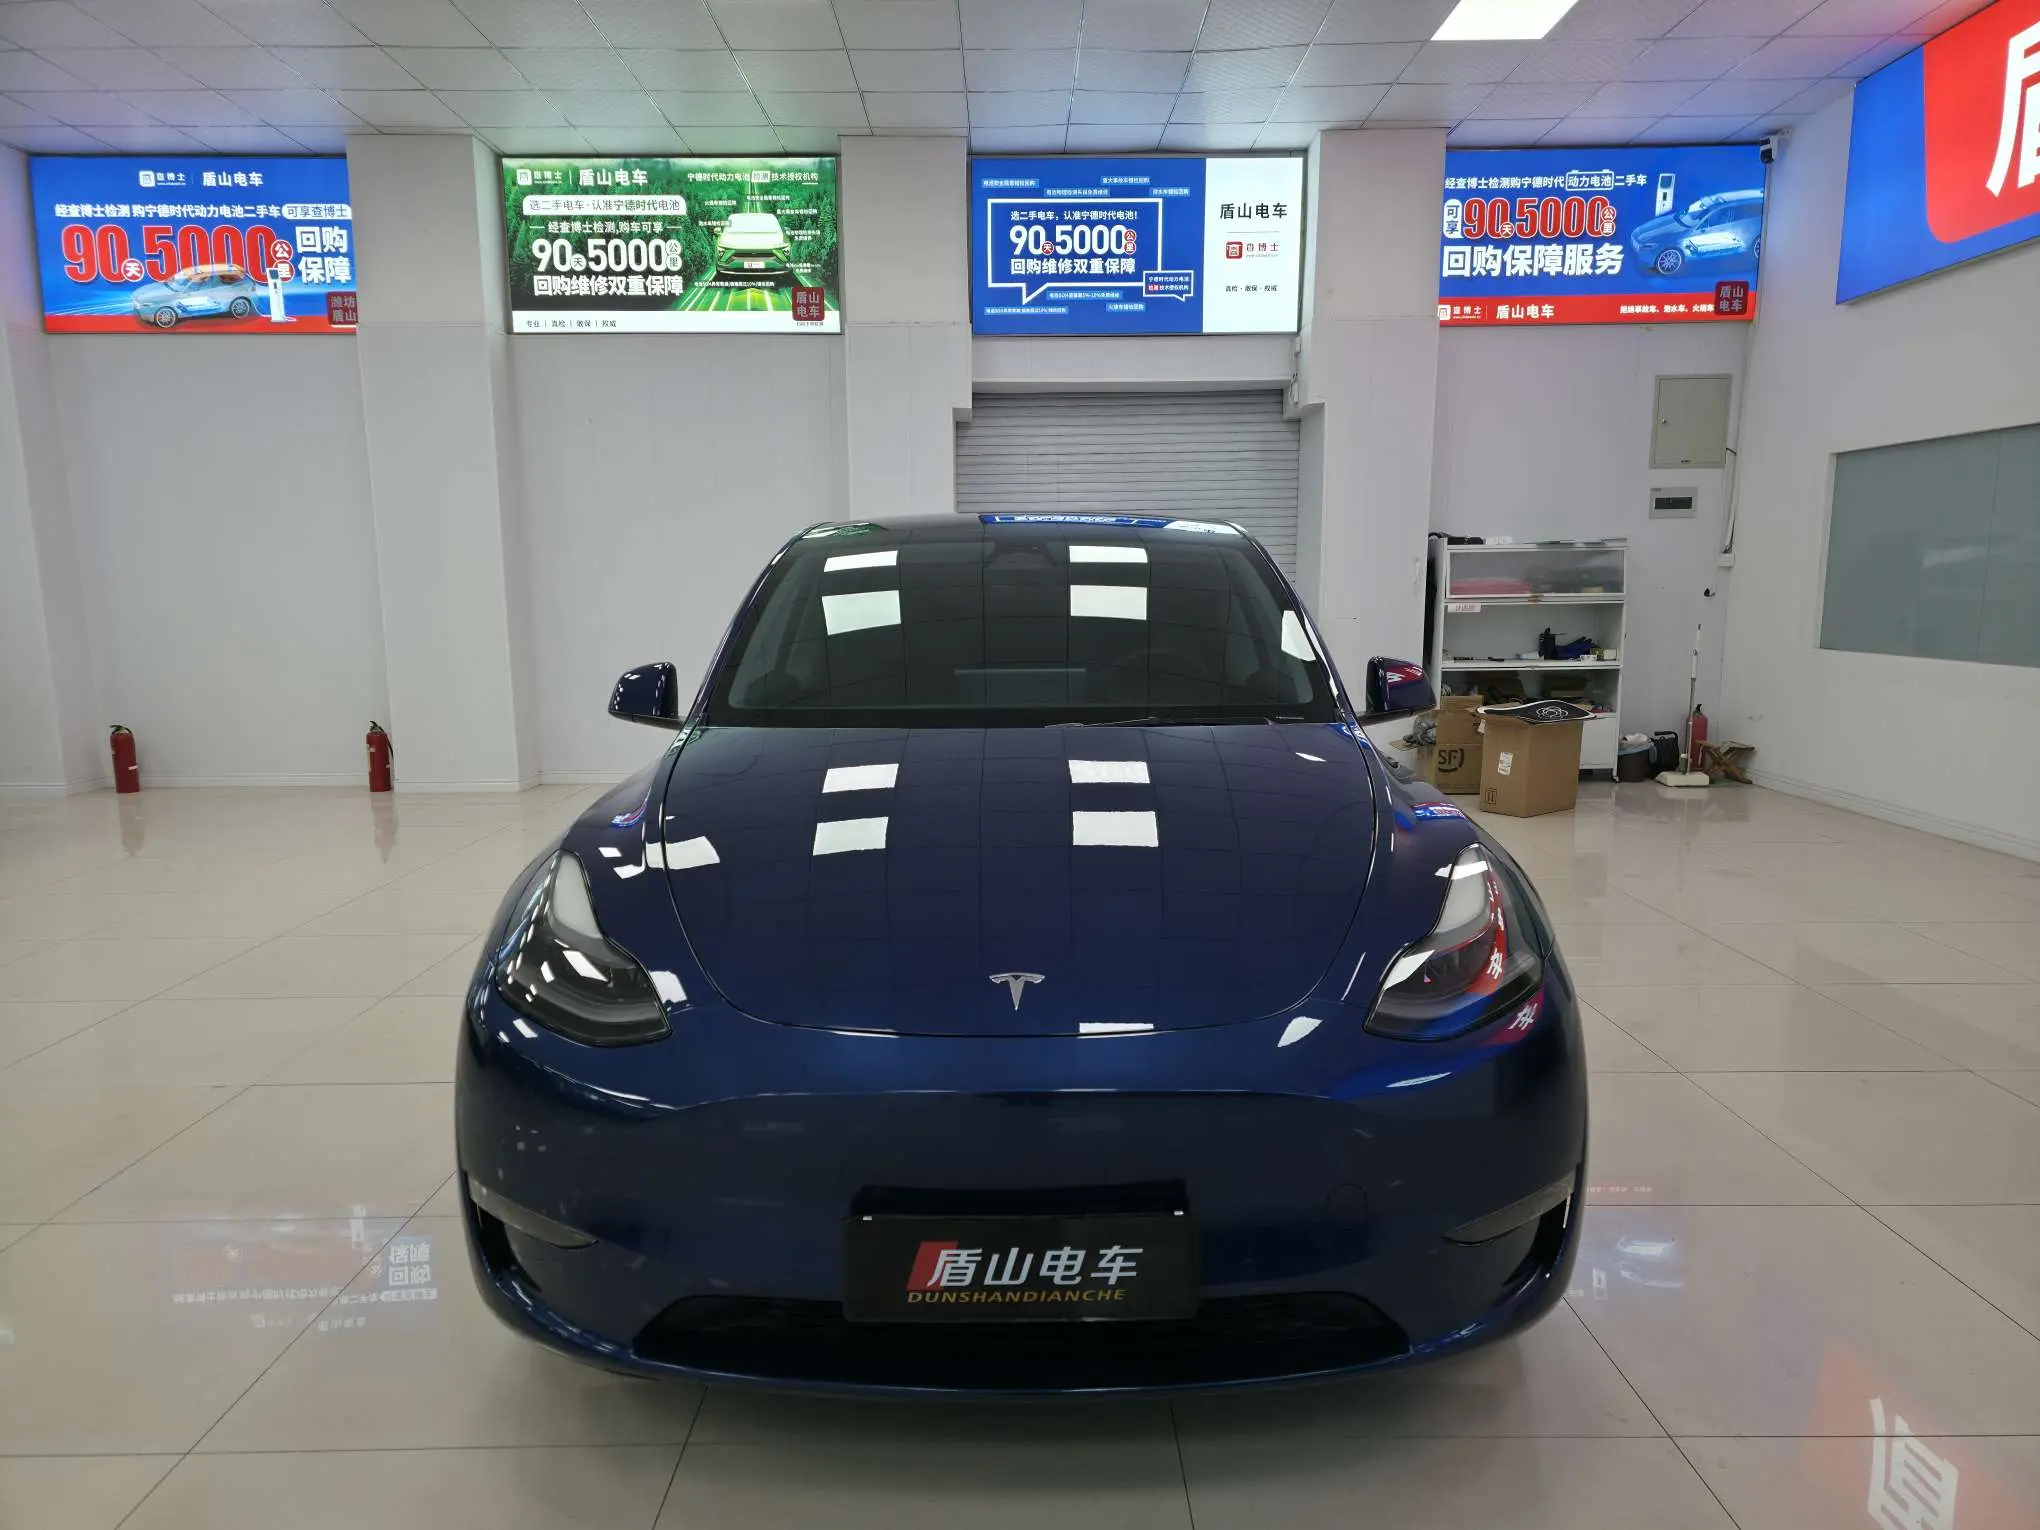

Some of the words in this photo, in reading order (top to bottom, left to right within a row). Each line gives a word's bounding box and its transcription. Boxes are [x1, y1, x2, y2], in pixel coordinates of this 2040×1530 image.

[202, 171, 263, 187] 盾山电车
[579, 169, 648, 186] 盾山电车
[1220, 203, 1288, 219] 盾山电车
[1446, 204, 1460, 235] 可享
[295, 226, 347, 253] 回购
[1010, 258, 1136, 275] 回购维修双重保障
[1442, 243, 1625, 278] 回购保障服务
[298, 256, 352, 283] 保障
[533, 275, 684, 296] 回购维修双重保障
[1719, 285, 1744, 299] 盾山
[1496, 304, 1555, 319] 盾山电车
[1719, 300, 1744, 313] 电车
[1438, 749, 1460, 766] SF
[926, 1245, 1144, 1287] 盾山电车
[907, 1289, 1129, 1304] DUNSHANDIANCHE
